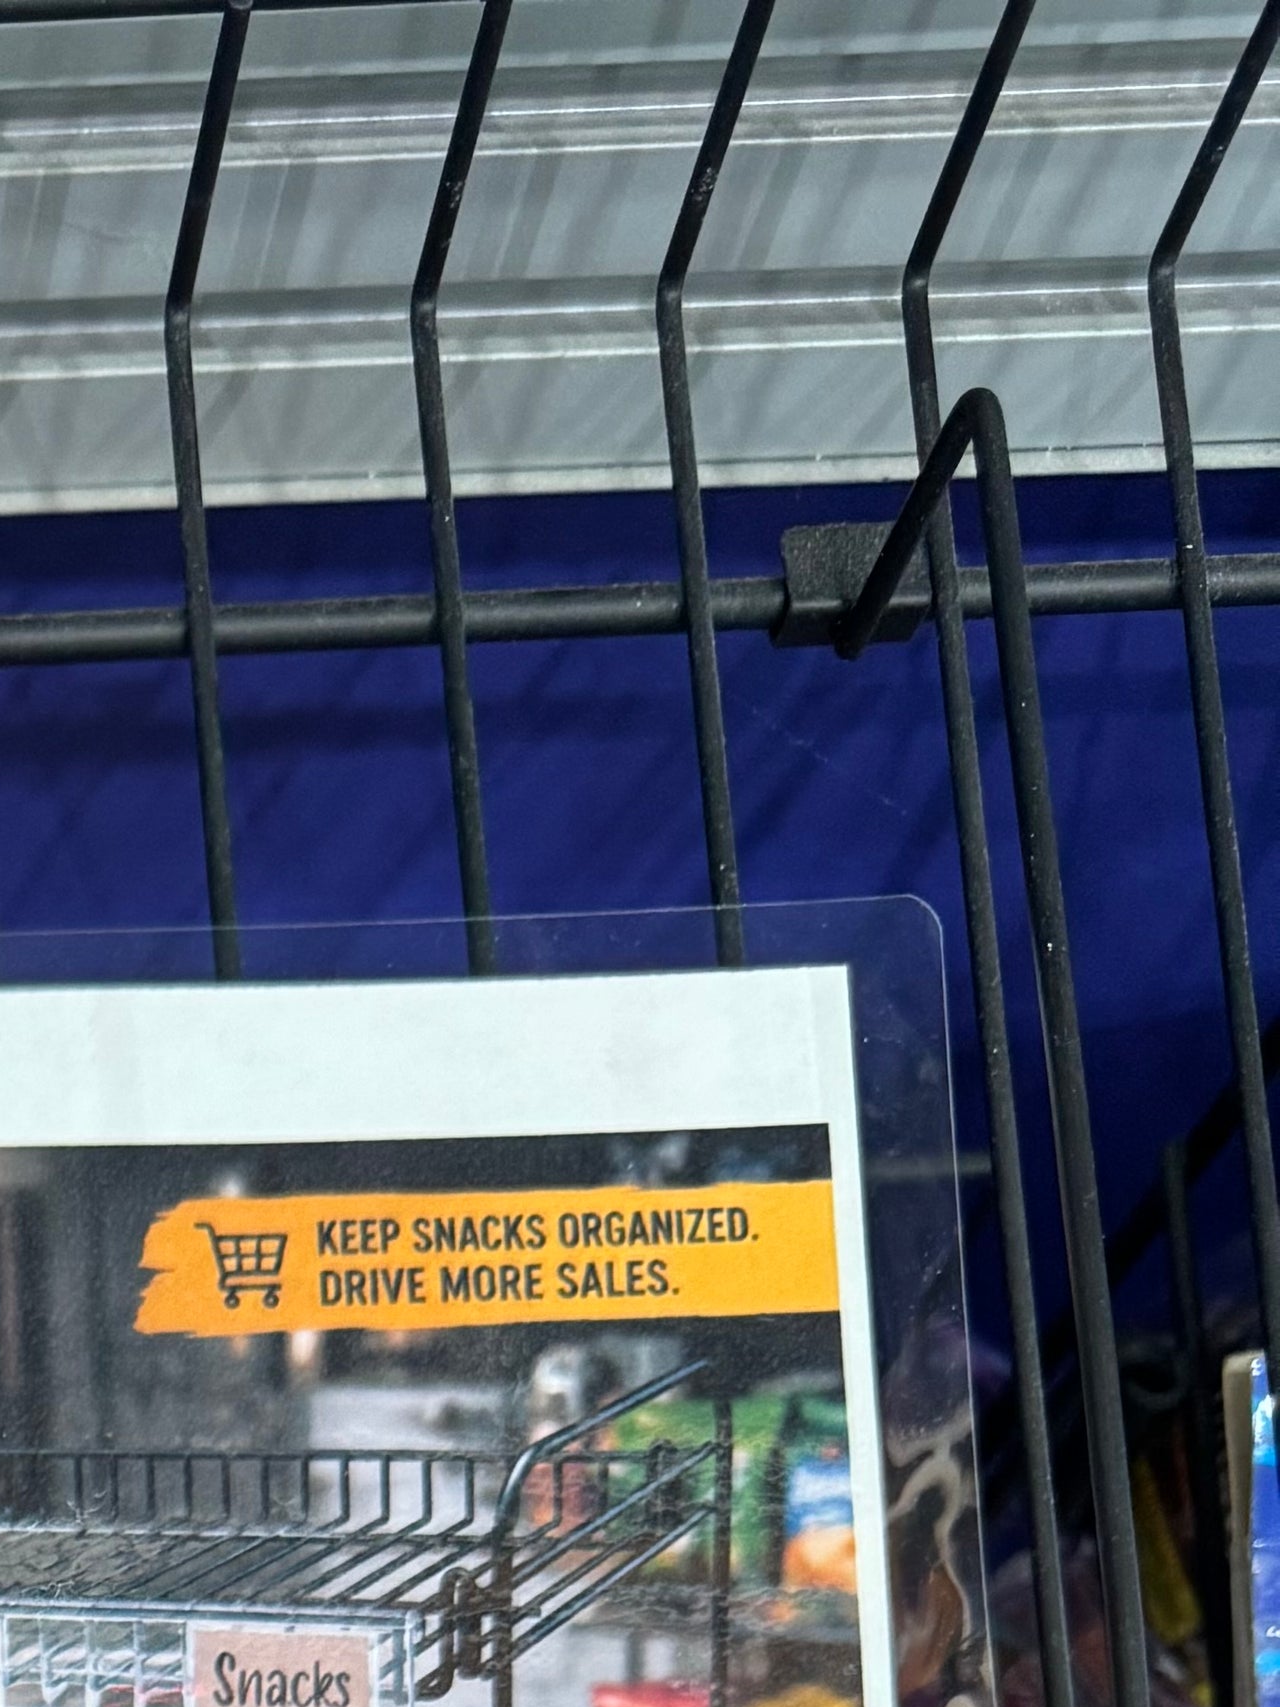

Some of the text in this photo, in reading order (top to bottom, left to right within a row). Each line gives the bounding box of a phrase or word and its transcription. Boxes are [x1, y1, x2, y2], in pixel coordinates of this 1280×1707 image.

[316, 1206, 759, 1257] KEEP SNACKS ORGANIZED.
[318, 1258, 680, 1307] DRIVE MORE SALES.
